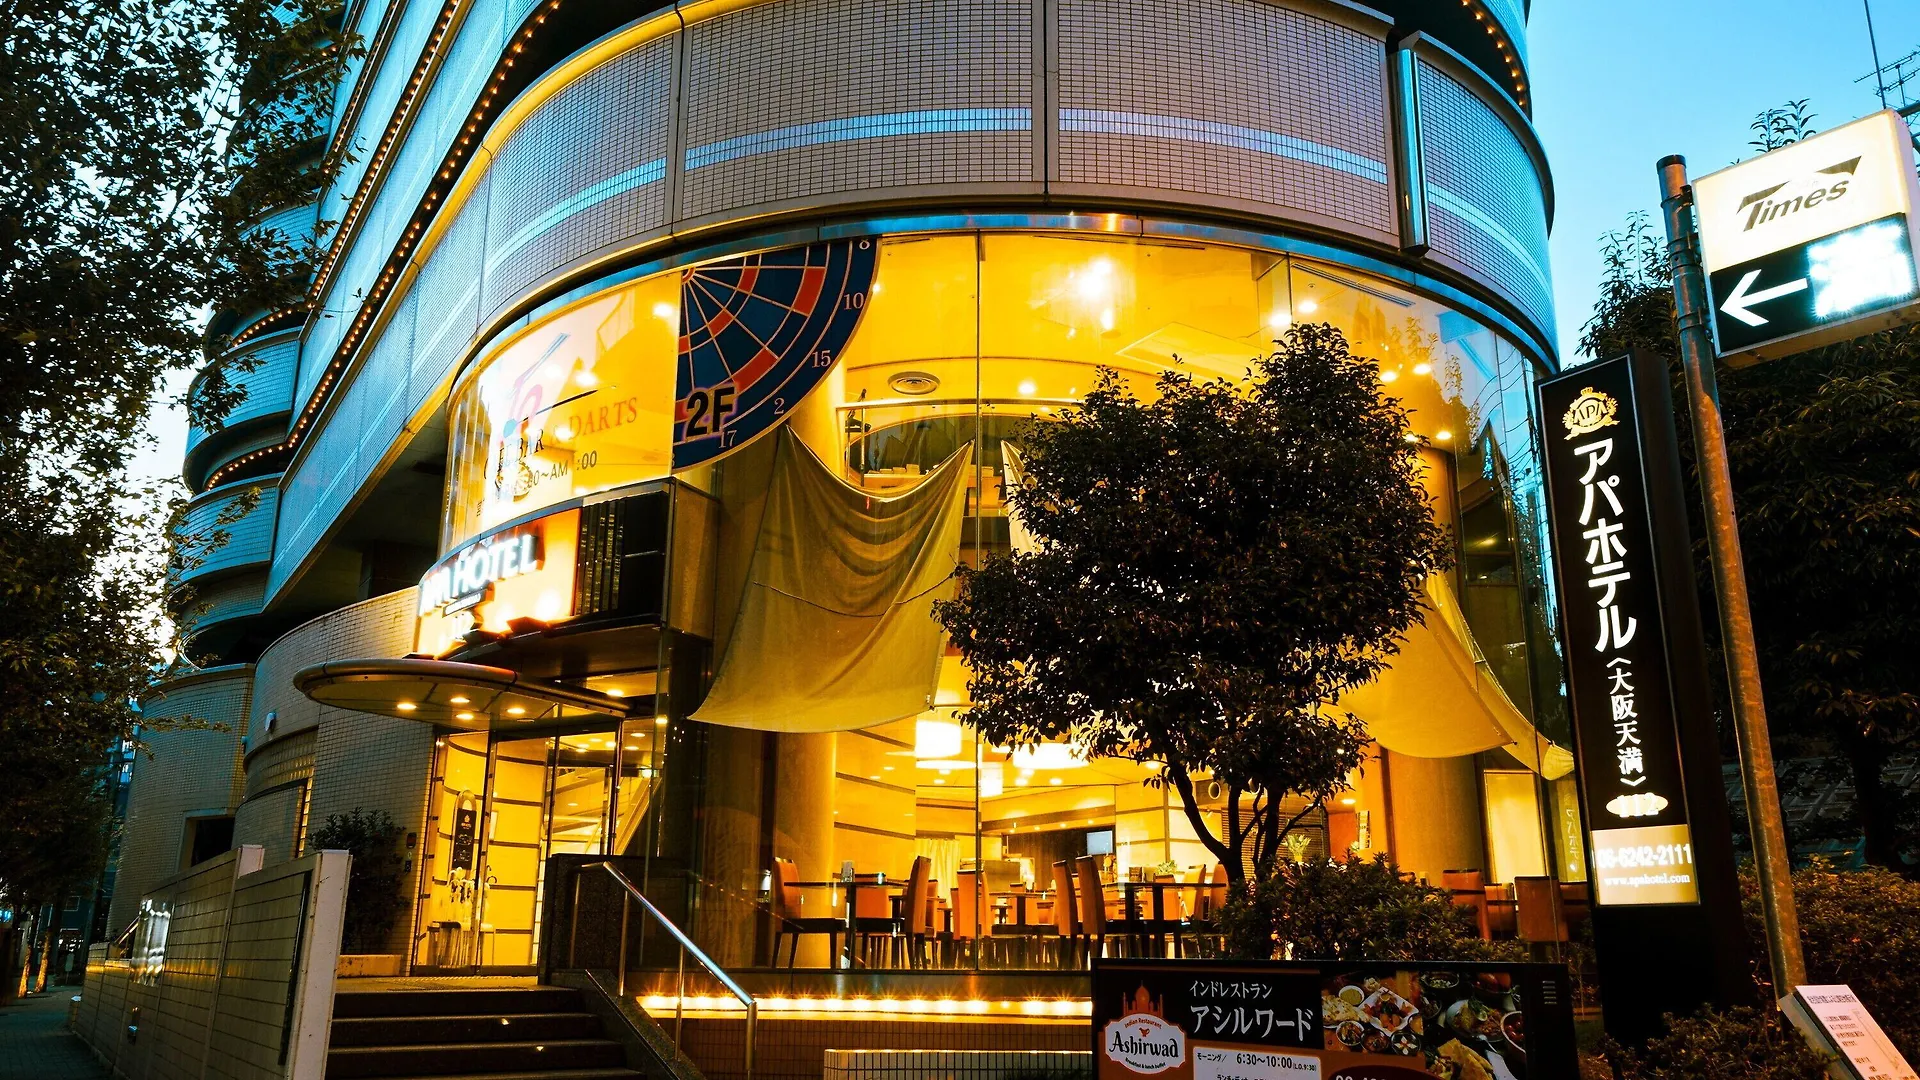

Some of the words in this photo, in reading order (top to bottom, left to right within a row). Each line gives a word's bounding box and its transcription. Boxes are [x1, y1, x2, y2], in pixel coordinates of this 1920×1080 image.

[1736, 156, 1861, 232] Times
[843, 292, 864, 310] 10
[811, 350, 831, 368] 15
[568, 397, 638, 440] DARTS
[686, 387, 735, 438] 2F
[774, 397, 785, 415] 2
[718, 430, 737, 448] 17
[1574, 437, 1637, 653] アパホテル
[452, 534, 537, 598] HOTEL
[1189, 980, 1273, 999] インドレストラン
[1190, 1005, 1314, 1042] アシルワード
[1109, 1031, 1179, 1058] Ashirwad
